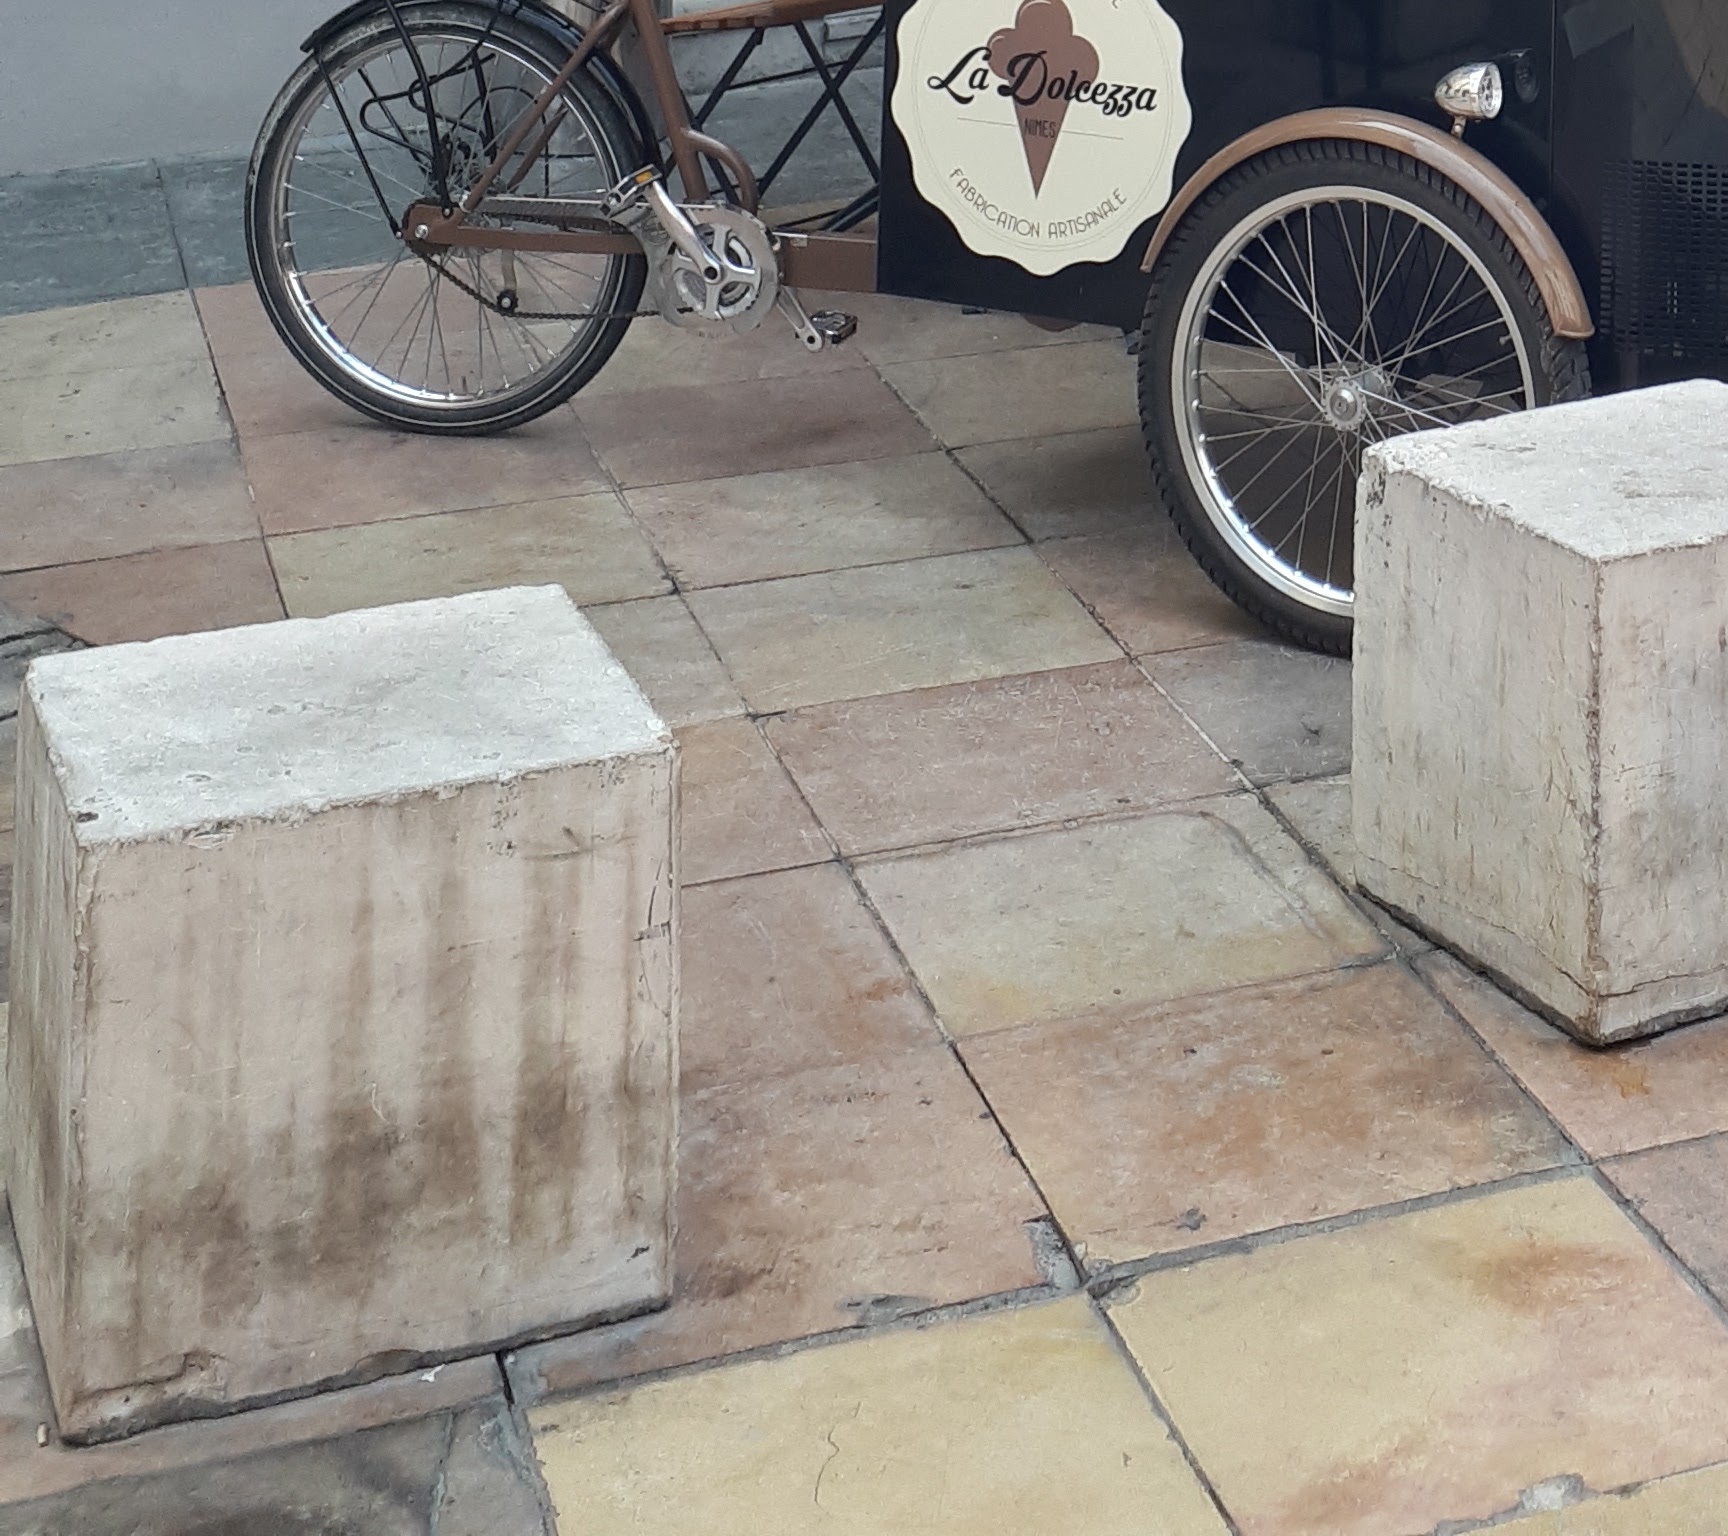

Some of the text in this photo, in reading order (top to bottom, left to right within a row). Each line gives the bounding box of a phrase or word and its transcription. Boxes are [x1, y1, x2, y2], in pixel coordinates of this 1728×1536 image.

[927, 46, 1157, 117] La Dolcezza
[949, 167, 1128, 239] FABRICATION ARTISANALE
